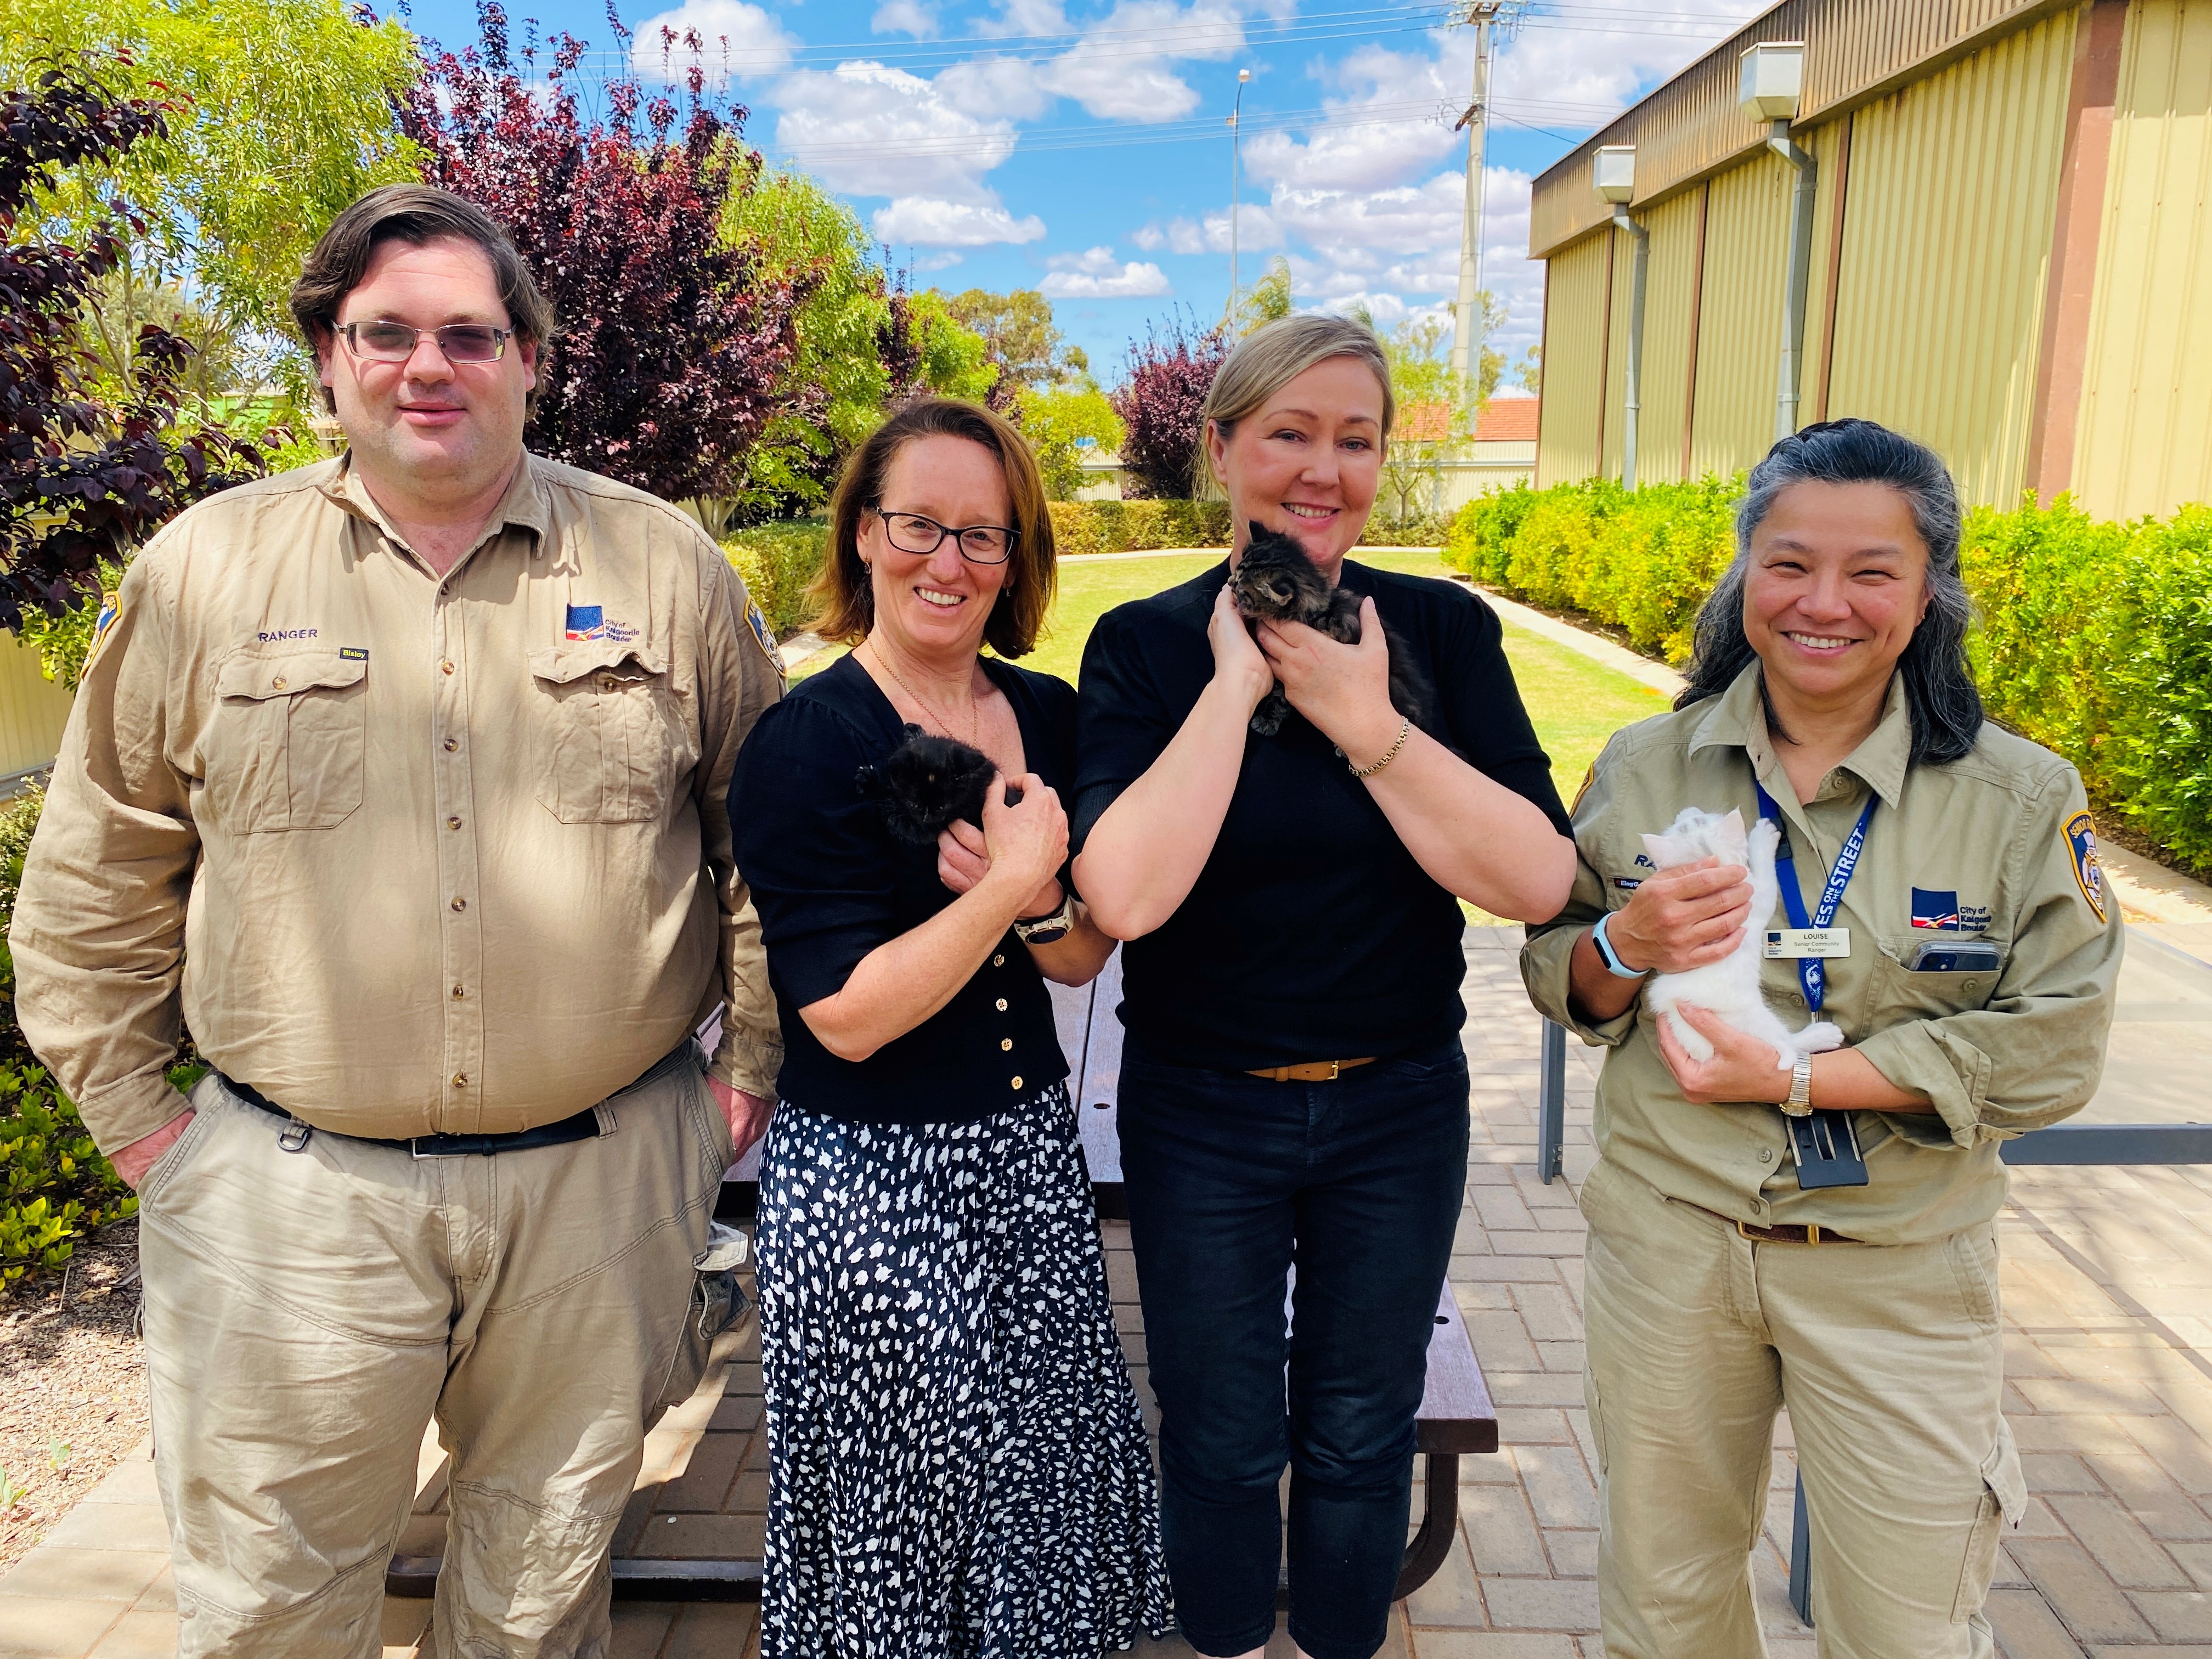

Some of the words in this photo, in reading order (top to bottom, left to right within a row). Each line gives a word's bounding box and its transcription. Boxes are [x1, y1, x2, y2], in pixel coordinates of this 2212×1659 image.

[605, 619, 618, 628] City
[258, 629, 318, 642] RANGER
[342, 650, 366, 658] Bisley
[1830, 828, 1864, 882] STREET
[1824, 887, 1835, 903] ON
[1831, 889, 1842, 904] THE
[1814, 905, 1833, 929] ES
[1960, 906, 1977, 915] City
